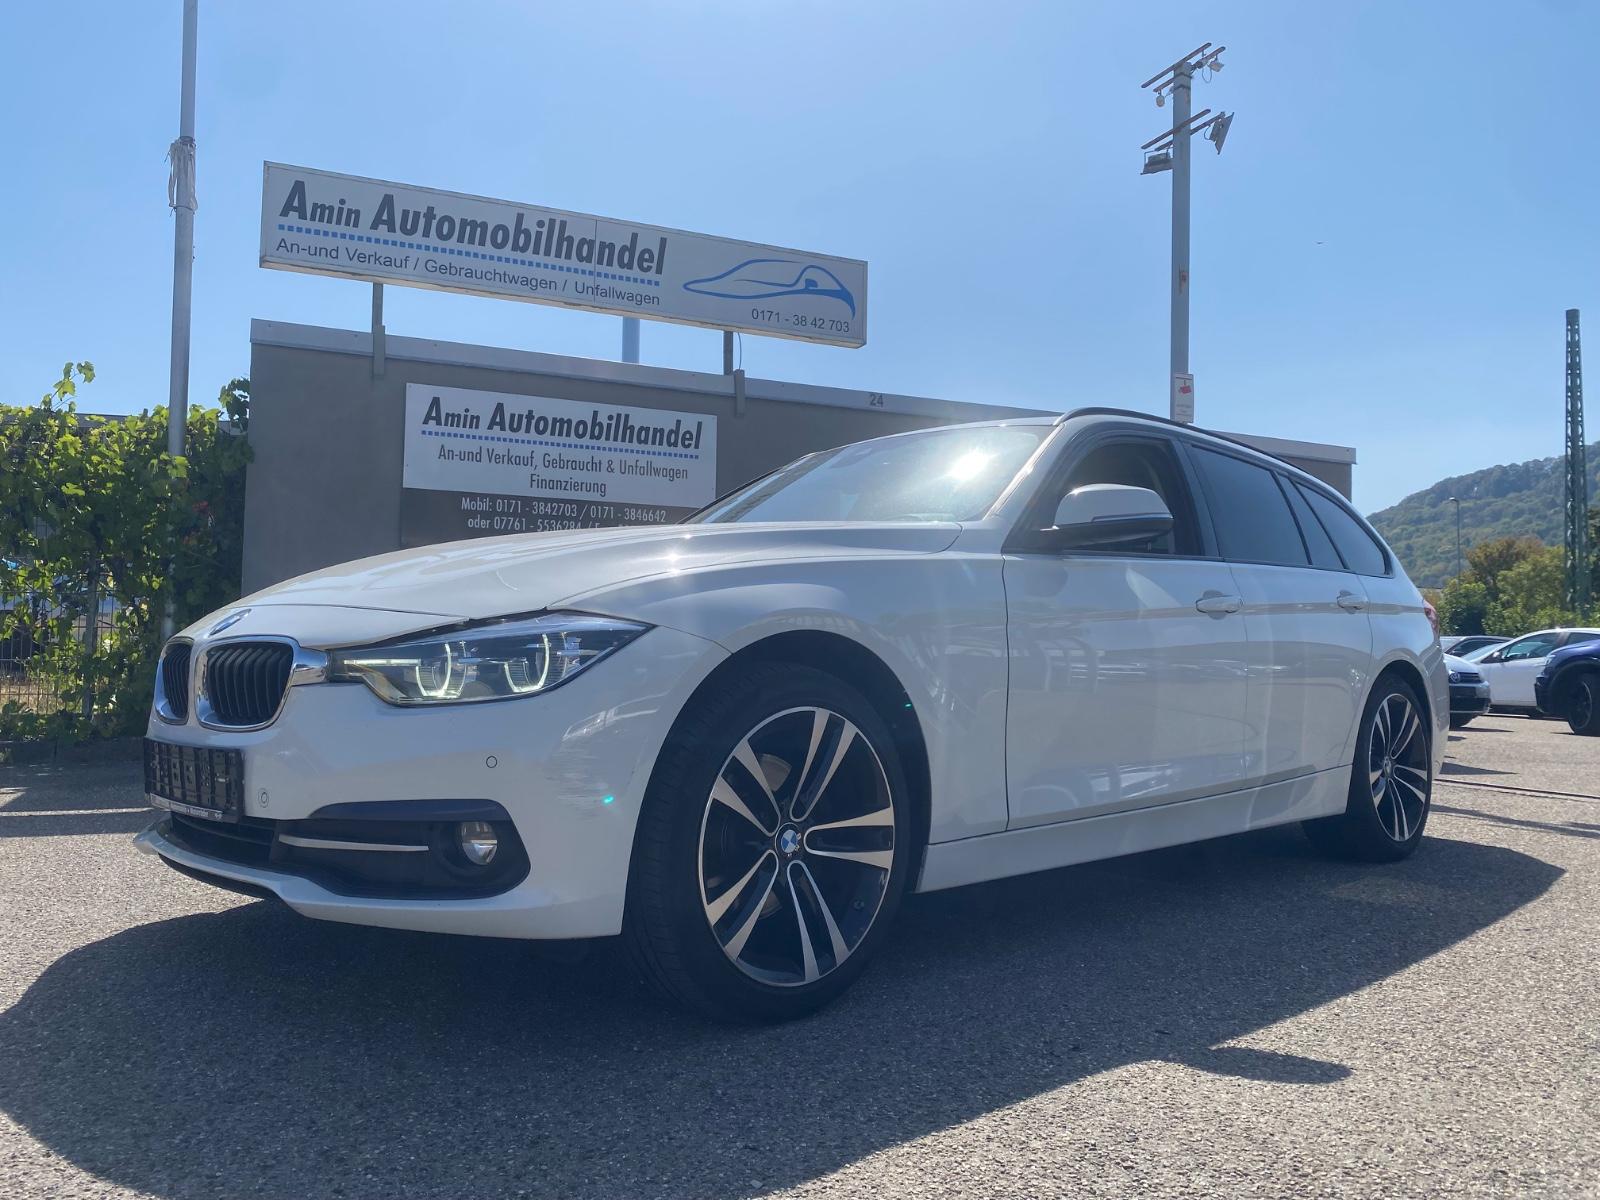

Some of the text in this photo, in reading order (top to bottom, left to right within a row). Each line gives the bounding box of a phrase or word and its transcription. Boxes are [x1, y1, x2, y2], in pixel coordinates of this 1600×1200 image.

[278, 179, 668, 275] Amin Automobilhandel
[276, 237, 339, 260] An-und
[345, 247, 411, 271] Verkauf
[424, 258, 557, 291] Gebrauchtwagen
[574, 280, 661, 305] Unfallwagen
[751, 308, 780, 323] 0171
[793, 314, 807, 327] 38
[810, 316, 825, 330] 42
[829, 319, 850, 333] 703
[870, 393, 884, 408] 24
[422, 396, 703, 449] Amin Automobilhandel
[438, 444, 688, 482] An-und Verkauf, Gebraucht & Unfallwagen
[530, 473, 607, 497] Finanzierung
[461, 497, 492, 511] Mobil:
[496, 499, 521, 513] 0171
[532, 501, 577, 517] 3842703
[590, 505, 614, 519] 0171
[624, 507, 667, 523] 3846642
[467, 514, 491, 529] oder
[494, 516, 526, 531] 07761
